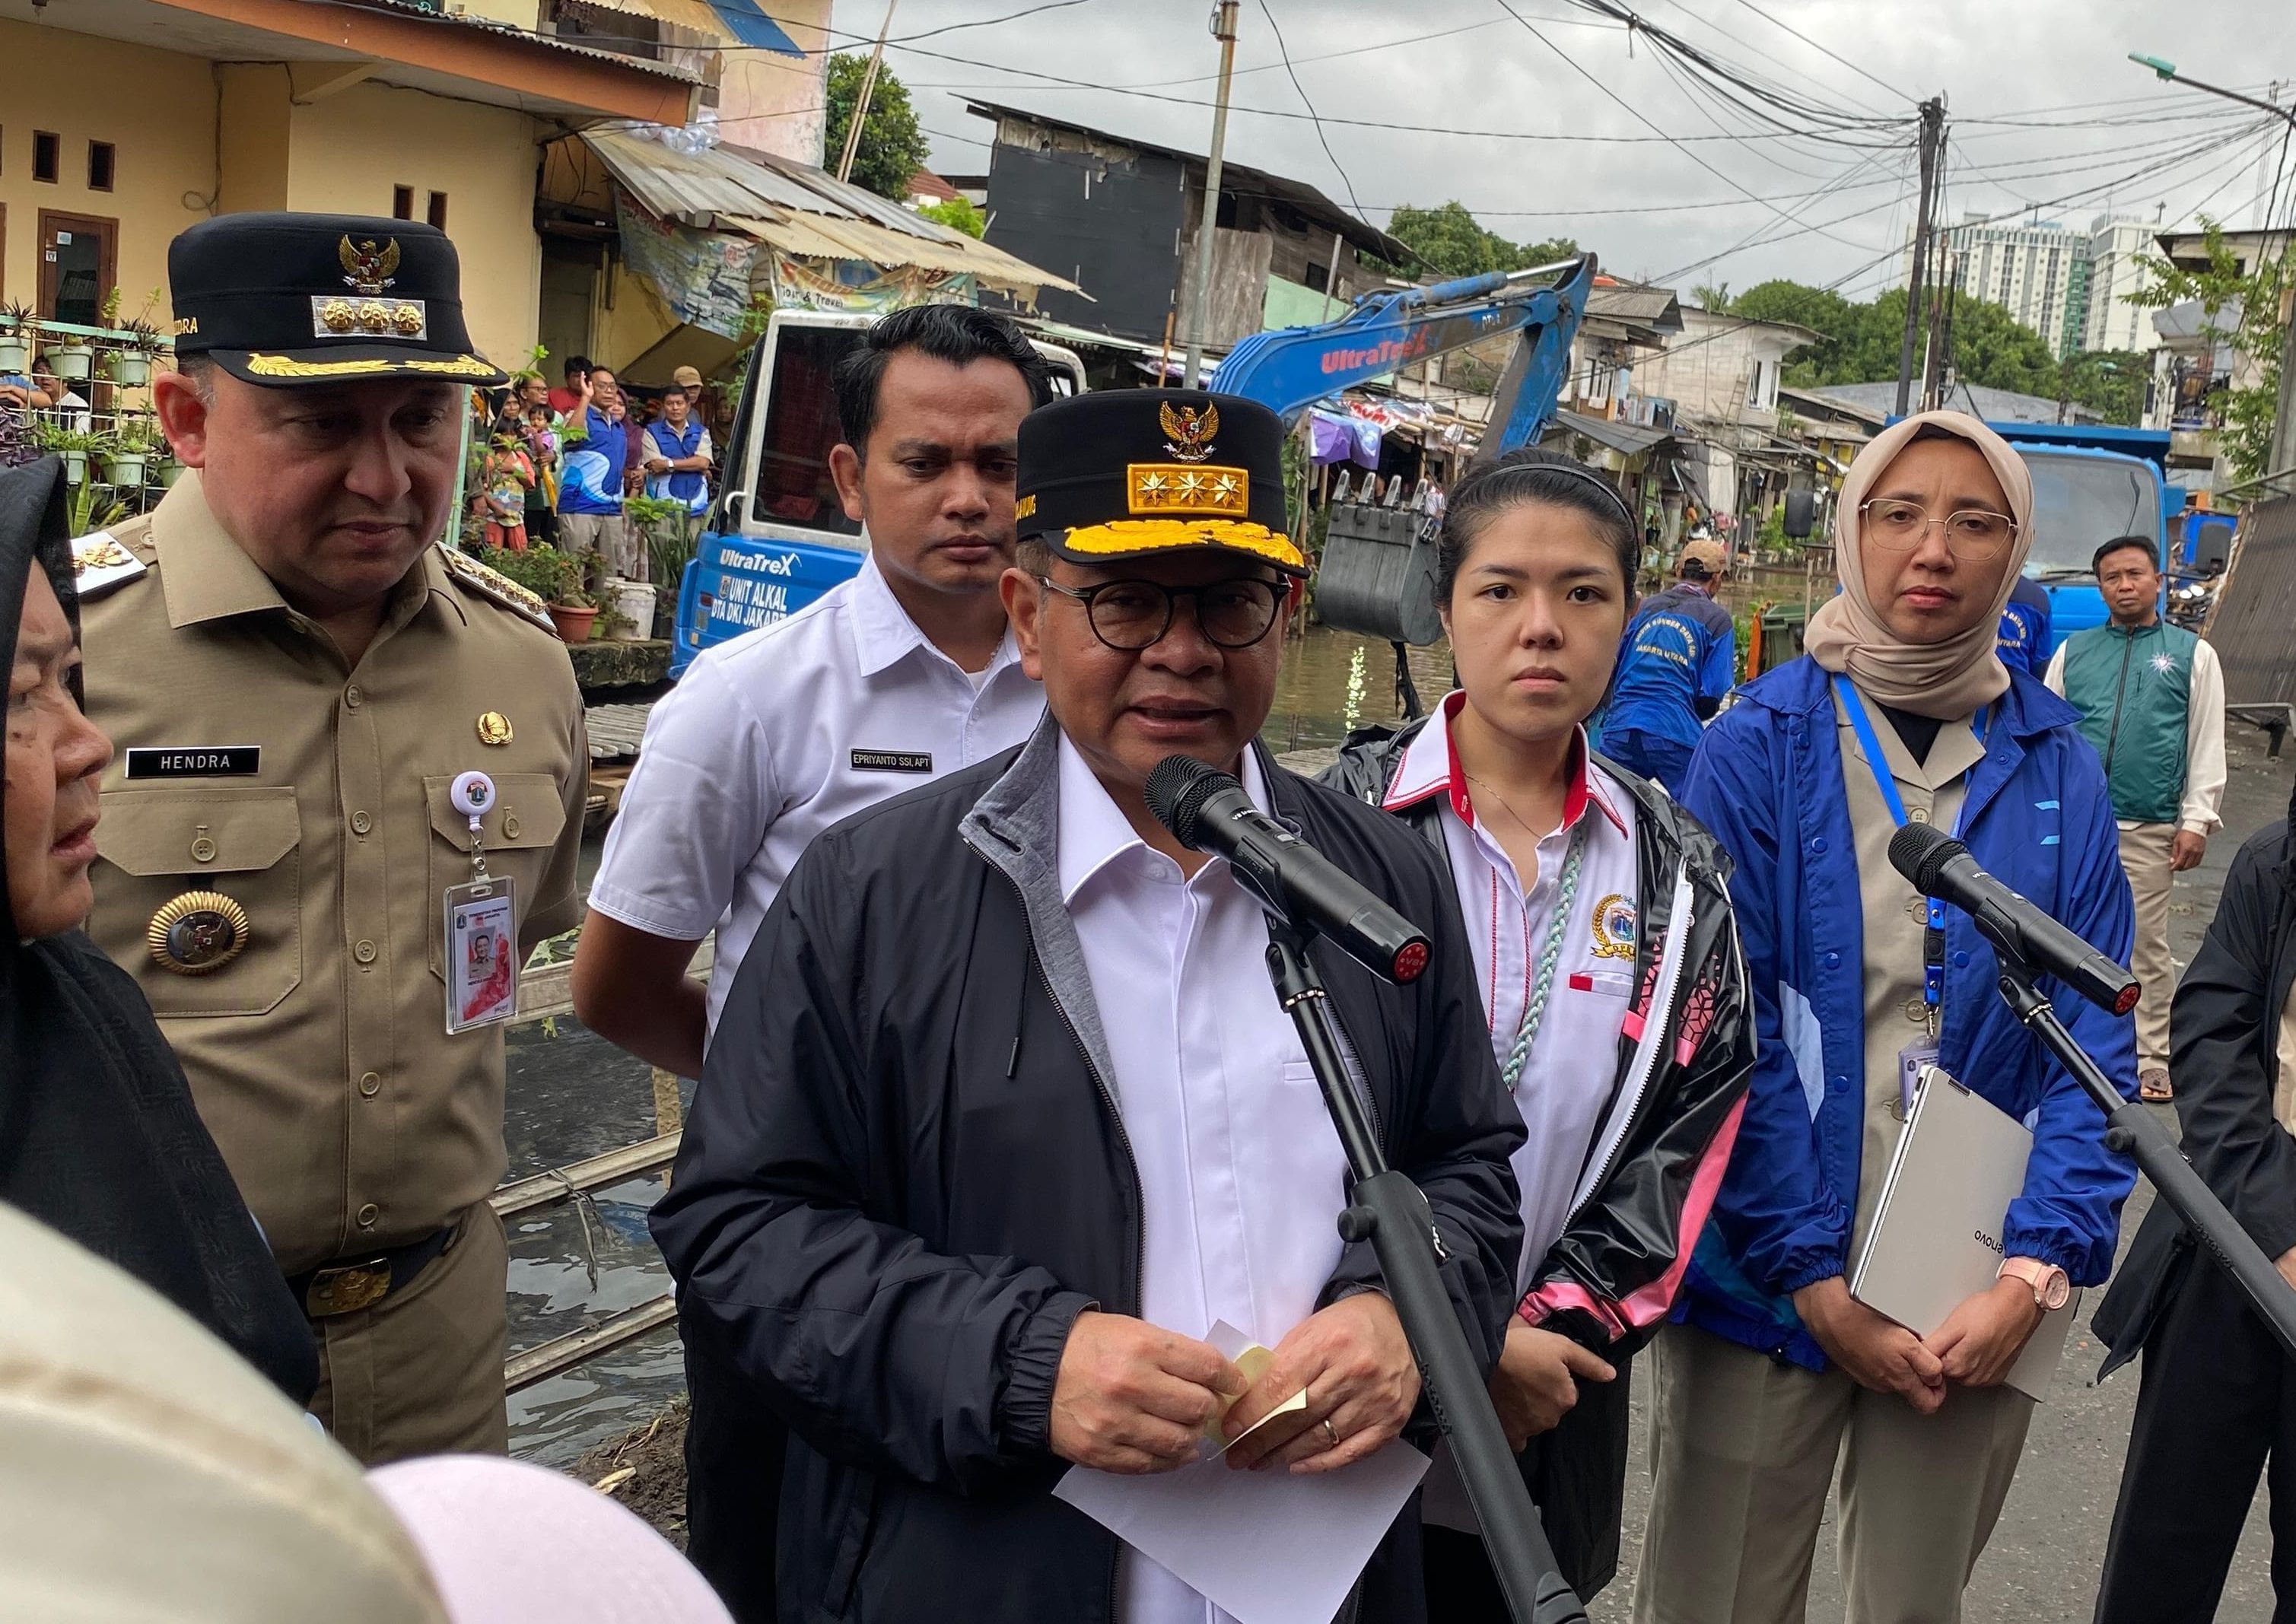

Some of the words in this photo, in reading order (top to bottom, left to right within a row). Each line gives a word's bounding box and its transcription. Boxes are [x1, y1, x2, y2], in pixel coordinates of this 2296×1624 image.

[803, 291, 812, 303] &
[720, 548, 793, 577] UltraTreX
[730, 577, 753, 604] UNIT
[751, 582, 787, 612] ALKAL
[743, 606, 788, 628] JAKAR
[161, 755, 231, 770] HENDRA
[853, 754, 897, 766] EPRIYANTO
[1612, 945, 1636, 955] DPR
[1974, 1229, 2004, 1254] enovo
